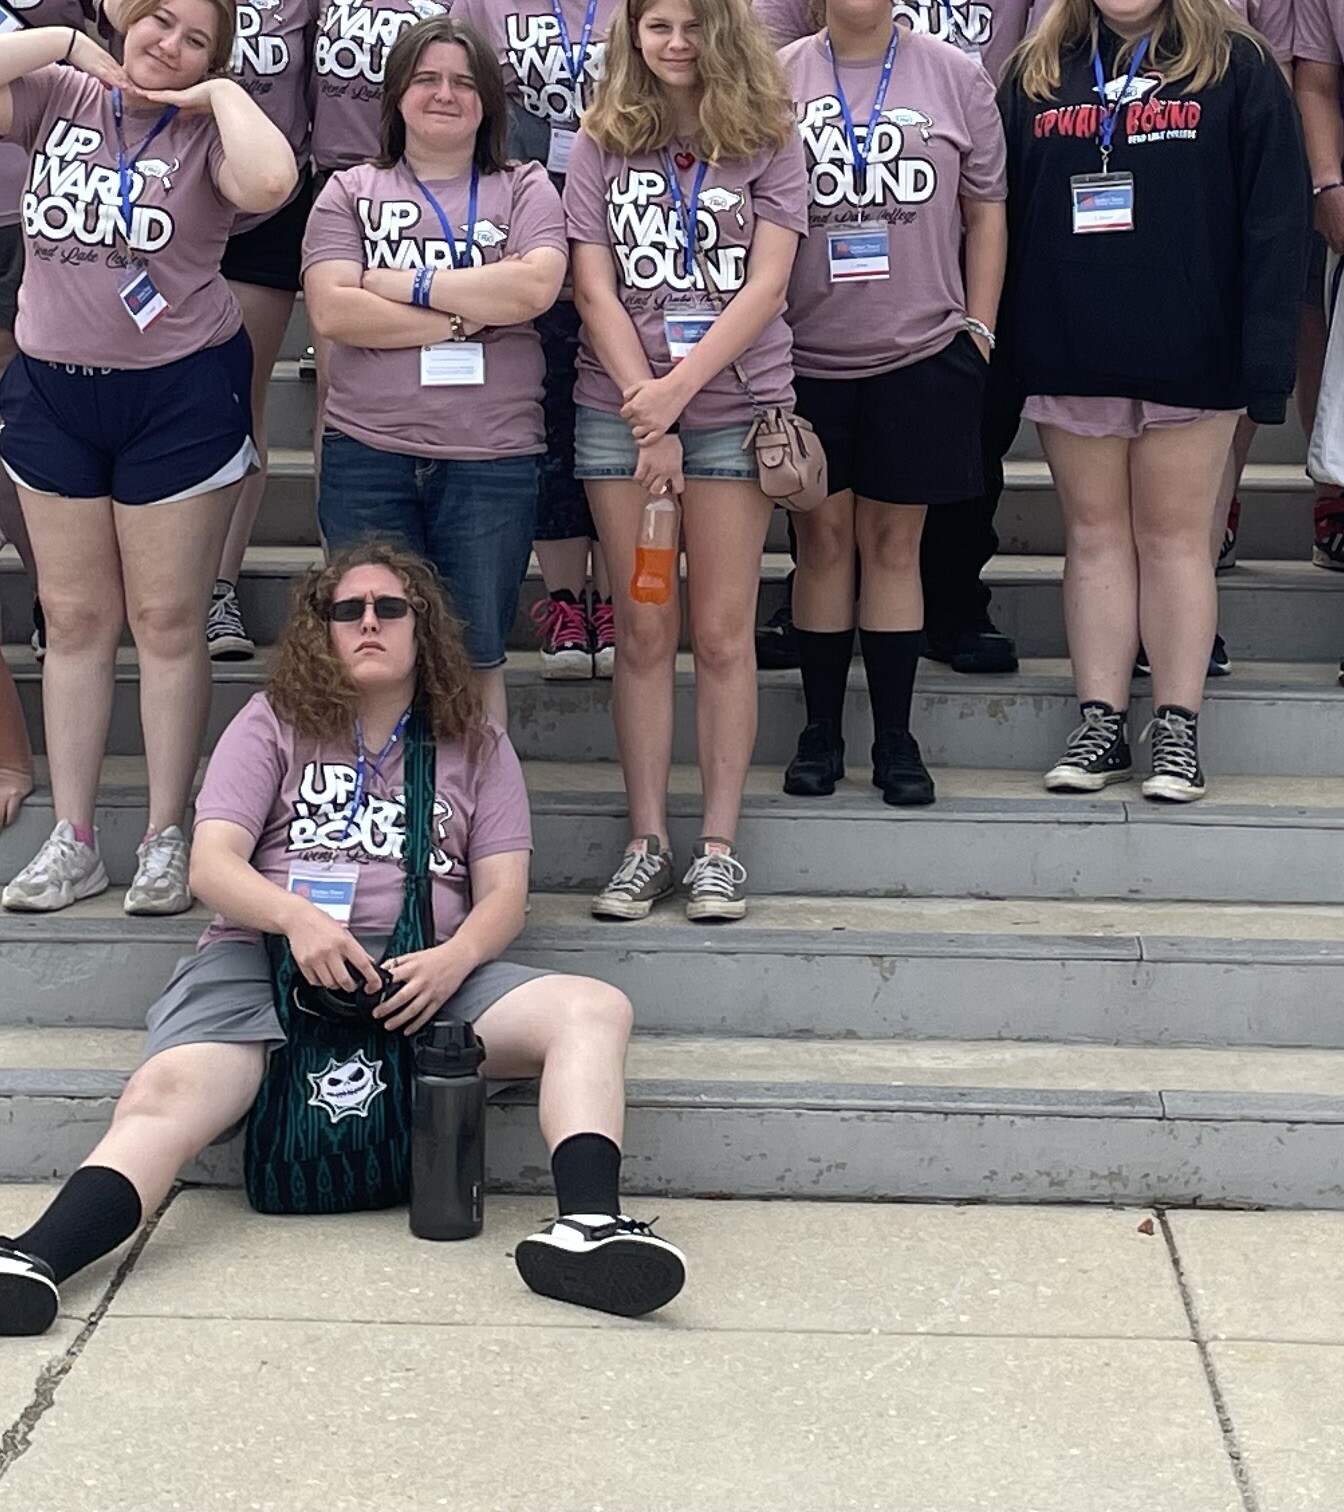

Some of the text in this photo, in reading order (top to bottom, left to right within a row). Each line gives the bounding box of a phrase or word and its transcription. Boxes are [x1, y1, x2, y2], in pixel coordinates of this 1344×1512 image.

[506, 13, 561, 49] UP
[1126, 99, 1201, 135] BOUND
[44, 119, 103, 162] UP
[606, 169, 667, 205] UP
[22, 191, 175, 253] BOUND
[357, 198, 422, 241] UP
[299, 761, 359, 804] UP
